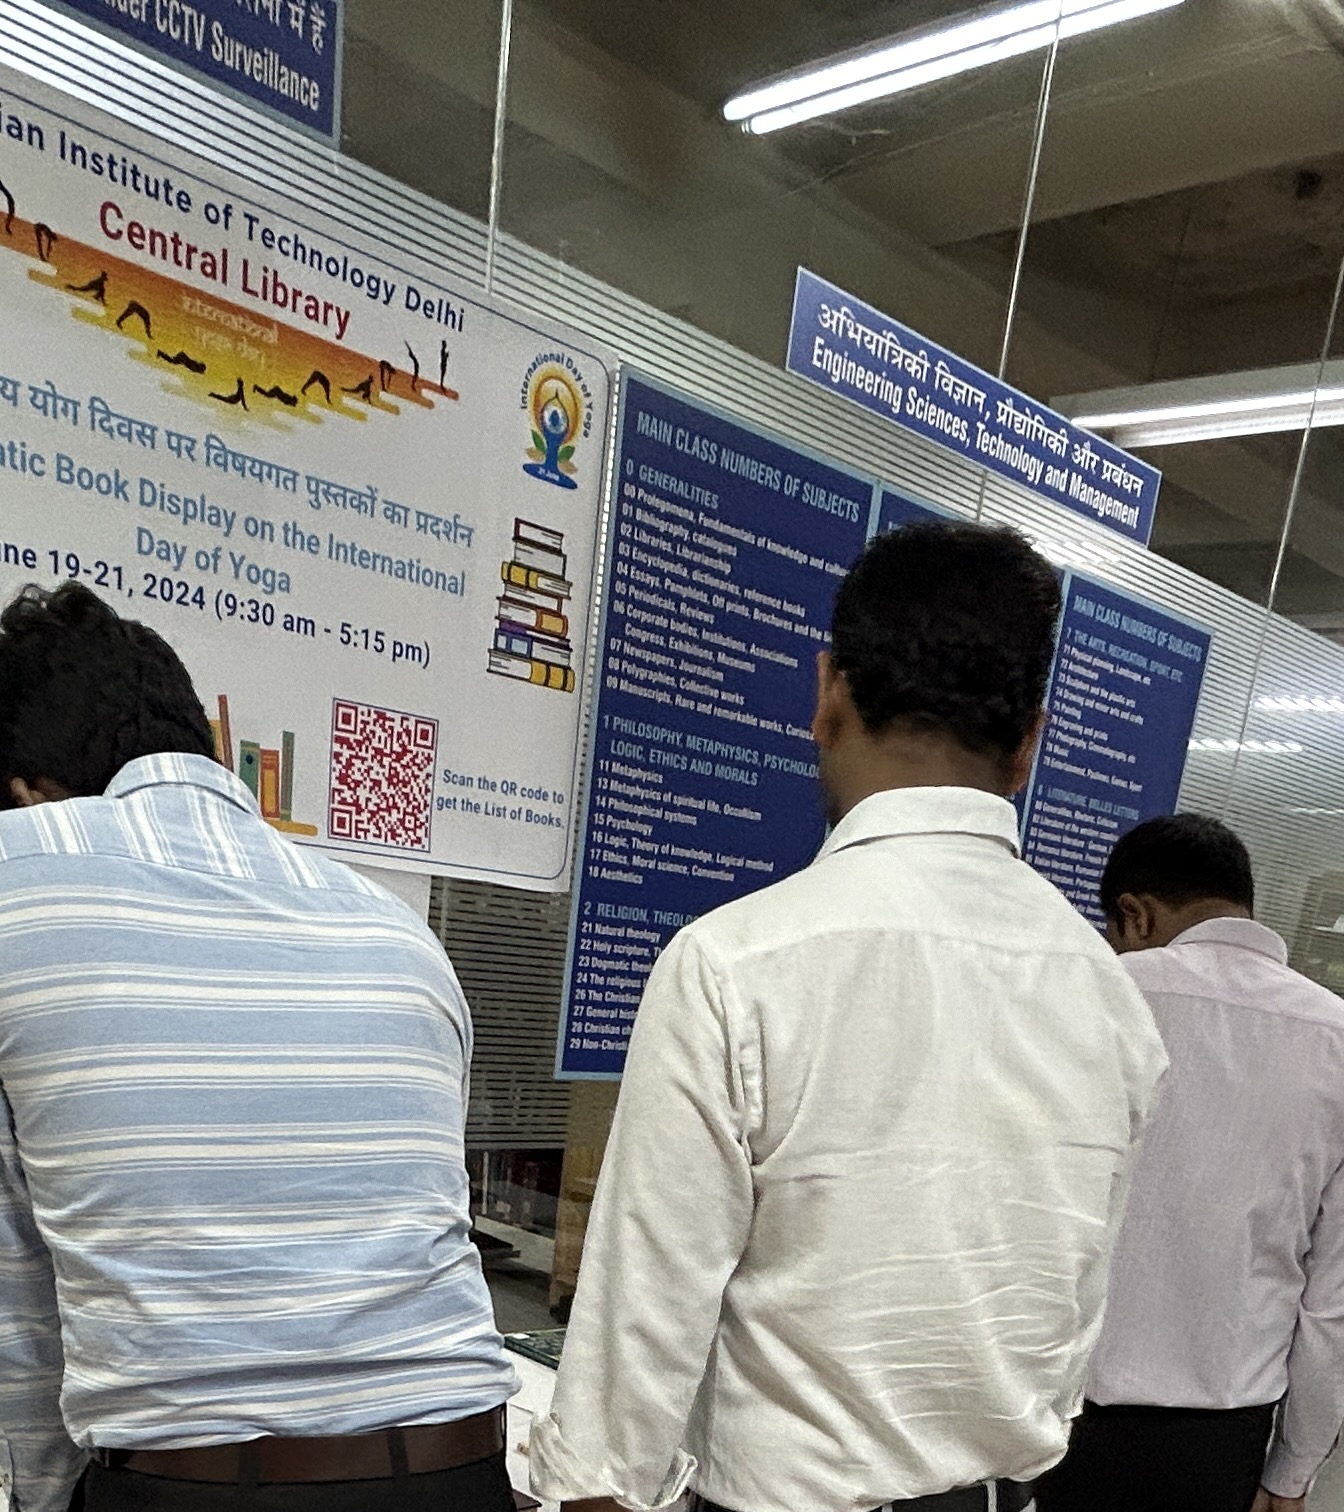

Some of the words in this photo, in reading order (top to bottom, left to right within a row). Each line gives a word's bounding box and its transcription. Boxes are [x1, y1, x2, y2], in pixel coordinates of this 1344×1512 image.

[155, 0, 205, 51] CCTV
[210, 20, 320, 111] Surveillance
[59, 130, 192, 214] Institute
[205, 203, 233, 231] of
[243, 212, 397, 306] Technology
[405, 286, 465, 332] Delhi
[100, 201, 228, 286] Central
[242, 258, 351, 340] Library
[520, 352, 565, 409] International
[566, 358, 584, 382] Day
[581, 383, 592, 399] of
[817, 303, 931, 383] अभियांत्रिकी
[934, 360, 991, 422] विज्ञान,
[996, 397, 1070, 459] प्रौद्योगिकी
[1071, 440, 1100, 476] और
[1102, 457, 1144, 498] प्रबंधन
[582, 402, 594, 438] Yoga
[811, 335, 903, 415] Engineering
[905, 386, 971, 449] Sciences,
[975, 421, 1045, 485] Technology
[1044, 463, 1069, 493] and
[1068, 471, 1141, 530] Management
[28, 379, 81, 427] योग
[89, 396, 158, 450] दिवस
[165, 429, 197, 461] पर
[205, 433, 300, 493] विषयगत
[305, 473, 378, 519] पुस्तकों
[382, 499, 410, 529] का
[415, 508, 475, 548] प्रदर्शन
[636, 410, 672, 445] MAIN
[675, 427, 717, 464] CLASS
[720, 447, 781, 491] NUMBERS
[783, 473, 800, 497] OF
[801, 481, 859, 522] SUBJECTS
[638, 464, 718, 509] GENERALITIES
[55, 452, 130, 502] Book
[138, 477, 236, 537] Display
[244, 515, 275, 544] on
[282, 520, 321, 556] the
[328, 533, 466, 598] International
[137, 526, 187, 572] Day
[195, 547, 222, 575] of
[229, 550, 292, 596] Yoga
[49, 549, 134, 598] 19-21,
[143, 573, 206, 611] 2024
[213, 589, 275, 627] (9:30
[282, 609, 316, 638] am
[338, 622, 386, 654] 5:15
[392, 638, 432, 670] pm)
[443, 769, 474, 788] Scan
[477, 775, 497, 792] the
[500, 780, 517, 797] QR
[520, 784, 549, 802] code
[552, 788, 564, 805] to
[648, 748, 687, 770] ETHICS
[688, 758, 712, 775] AND
[714, 763, 758, 786] MORALS
[436, 796, 457, 811] get
[461, 797, 481, 814] the
[484, 801, 507, 819] List
[510, 806, 522, 821] of
[525, 809, 566, 829] Books.
[583, 901, 591, 915] 2
[596, 902, 649, 924] RELIGION,
